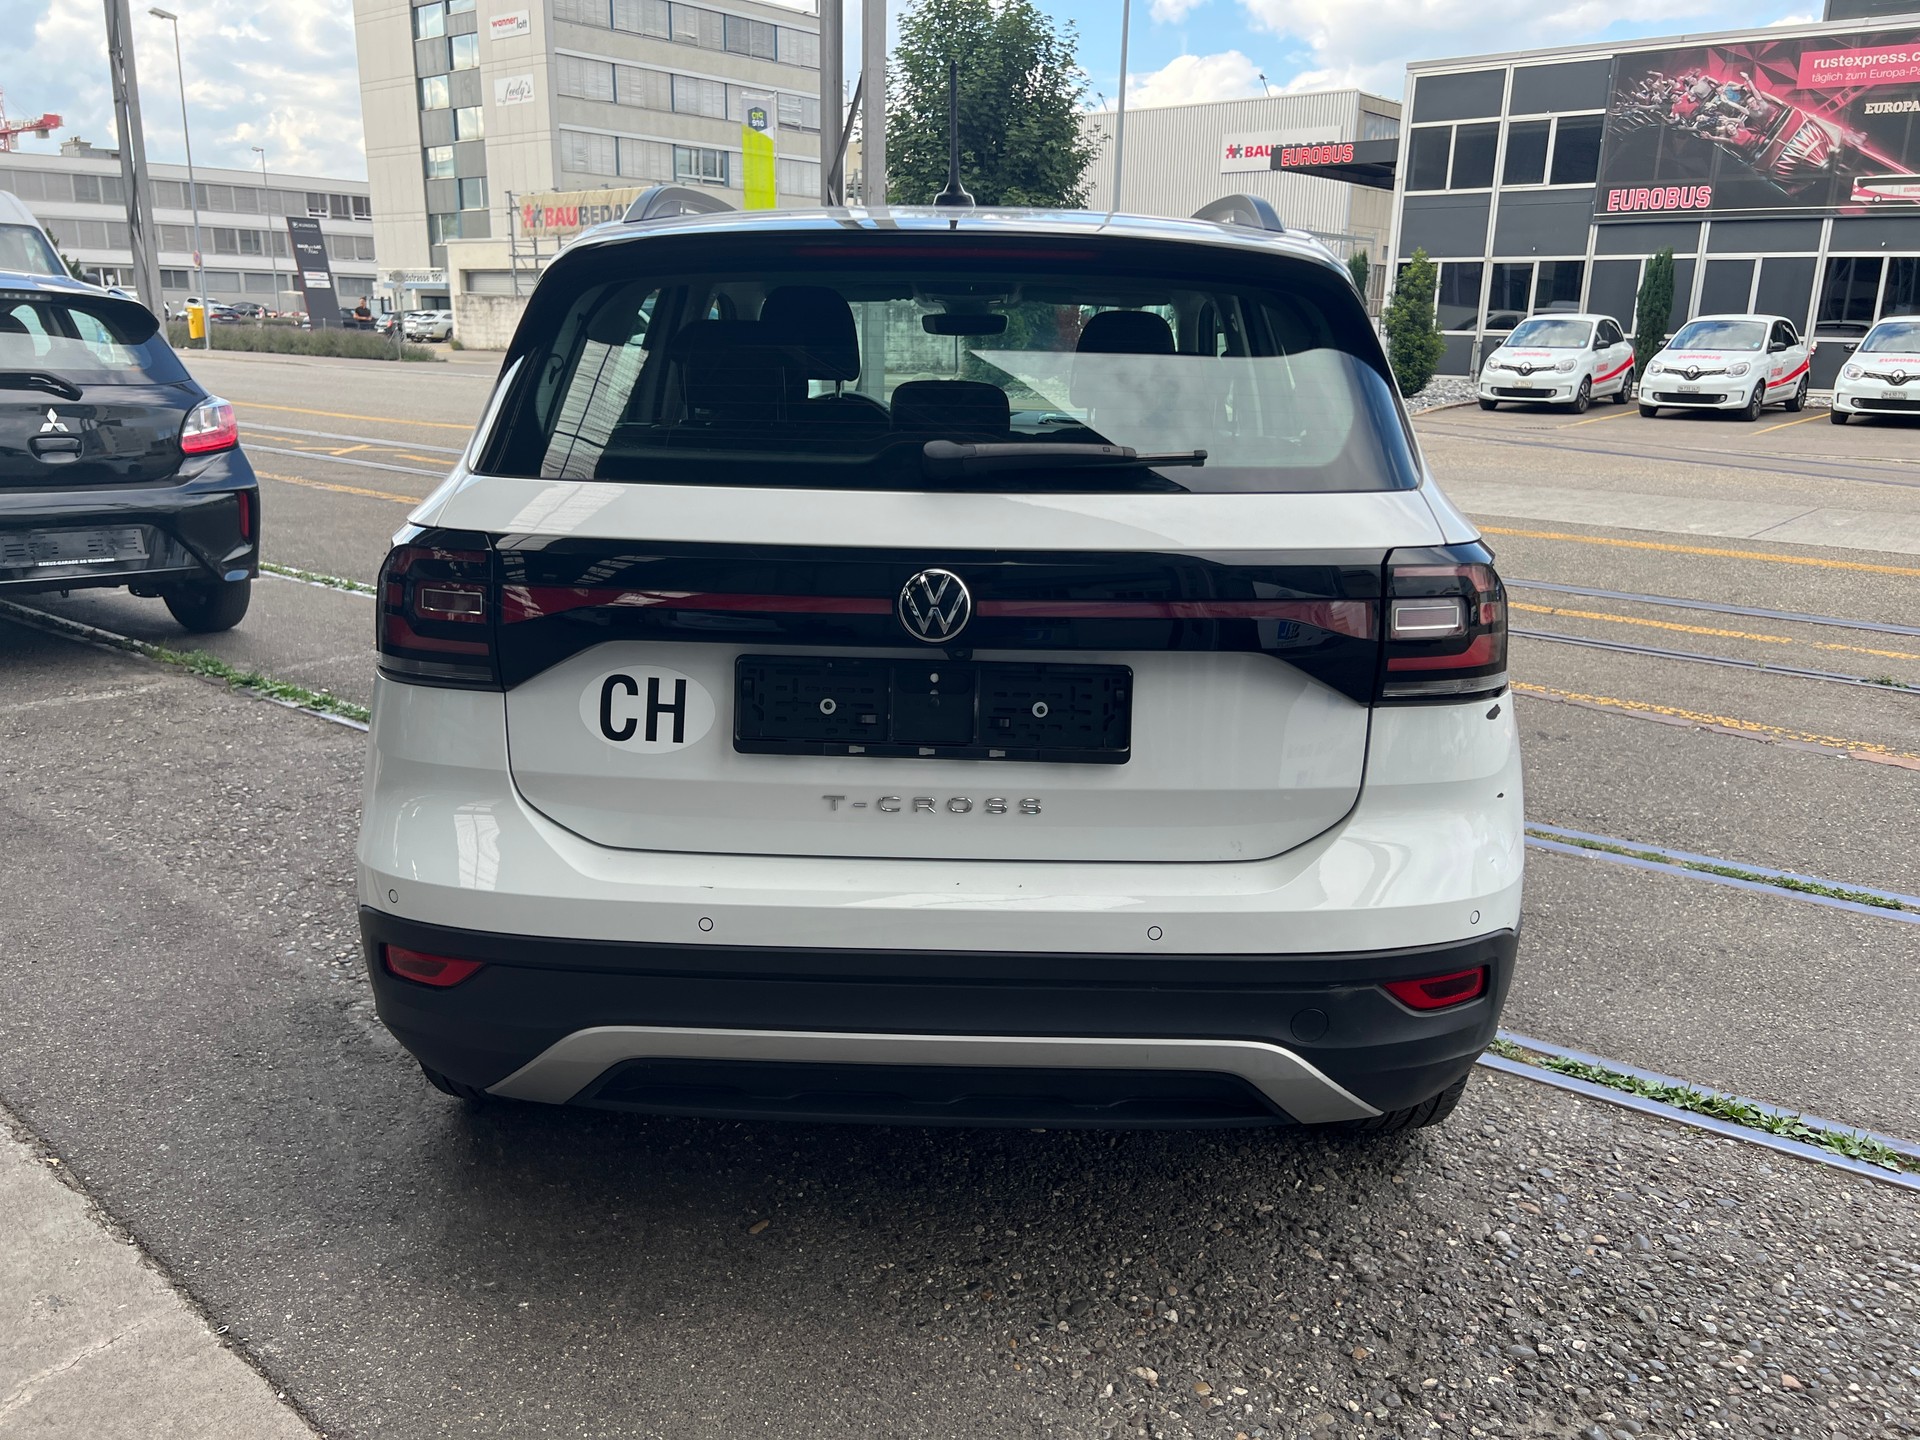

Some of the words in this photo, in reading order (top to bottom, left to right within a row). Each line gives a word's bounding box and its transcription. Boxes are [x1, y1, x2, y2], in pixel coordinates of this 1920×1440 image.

[1811, 72, 1843, 84] täglich
[1845, 71, 1867, 81] zum
[1864, 100, 1920, 115] EUROPA
[1281, 143, 1354, 167] EUROBUS
[1606, 185, 1712, 212] EUROBUS
[545, 203, 632, 227] BAUBEDA
[600, 673, 687, 743] CH
[823, 794, 1043, 815] T-CROSS
